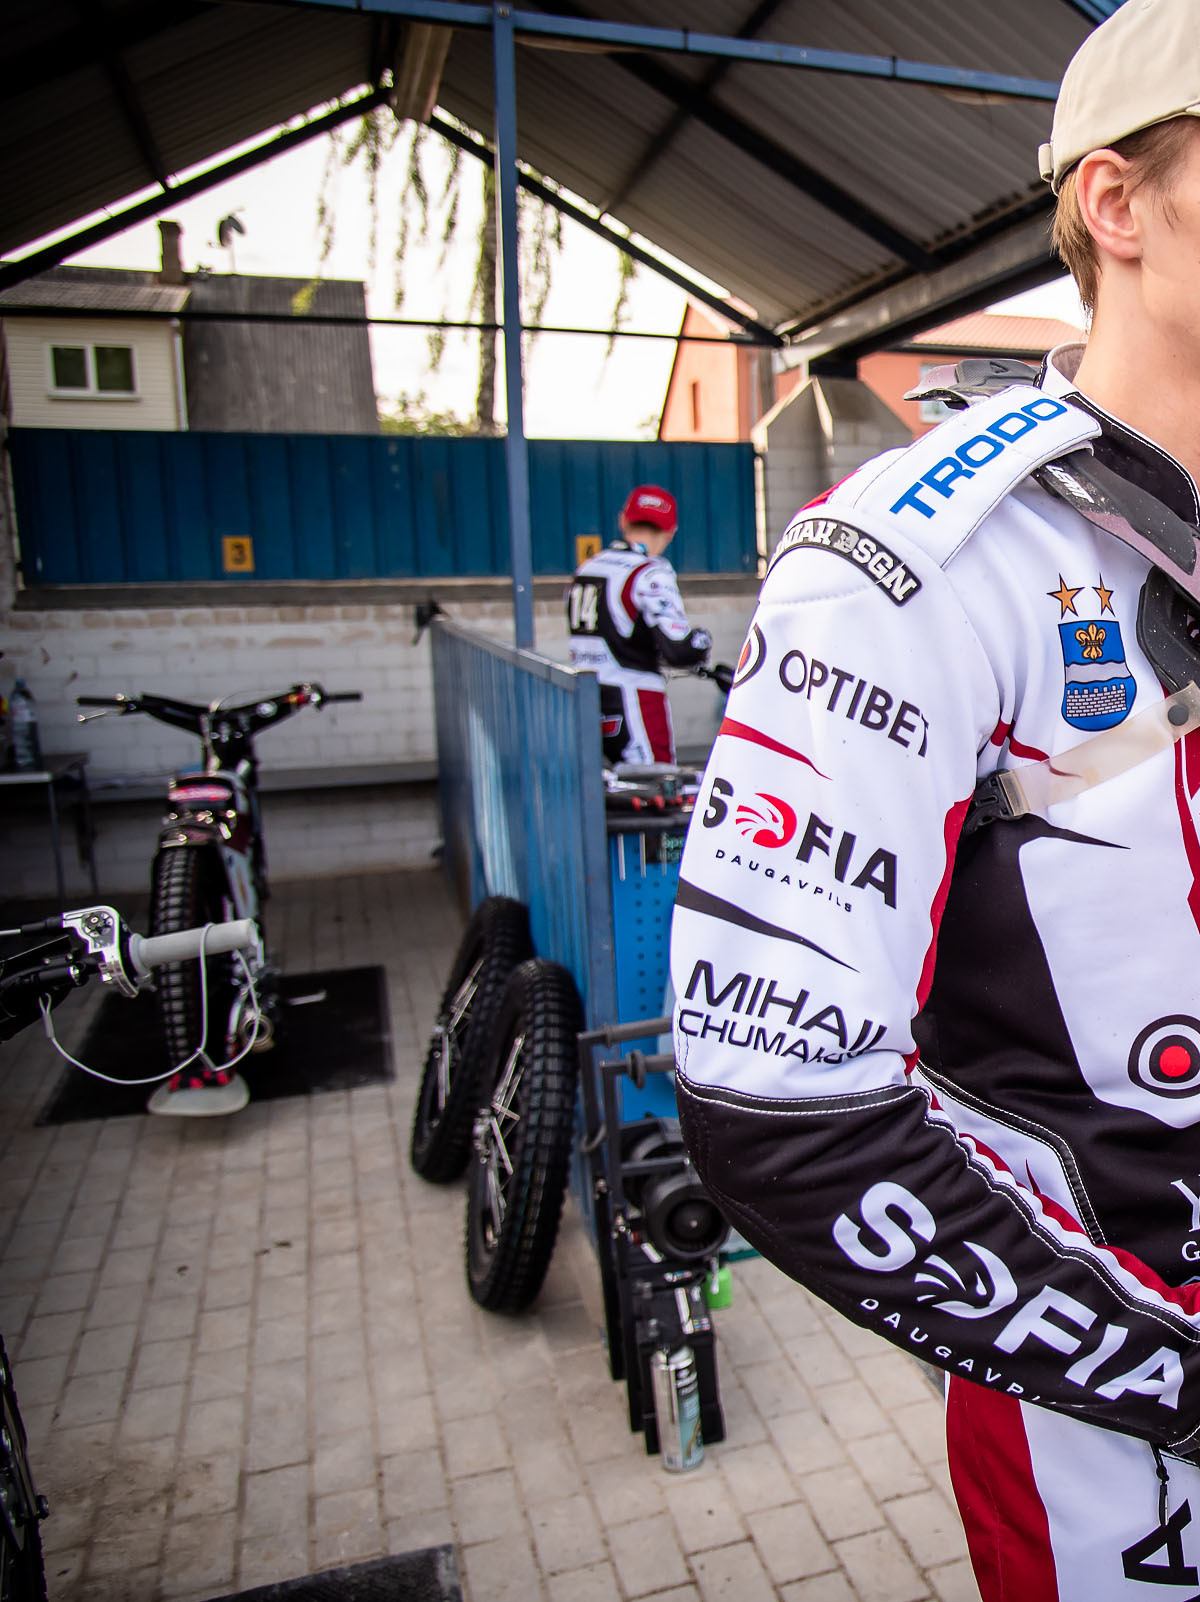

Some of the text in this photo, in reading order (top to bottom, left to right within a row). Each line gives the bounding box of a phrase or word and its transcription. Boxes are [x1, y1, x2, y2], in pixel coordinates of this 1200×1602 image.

[889, 398, 1068, 519] TRODO
[231, 541, 247, 566] 3
[570, 582, 599, 632] 14
[715, 849, 852, 912] DAUGAVPILS
[860, 1297, 1088, 1408] DAUGAVP
